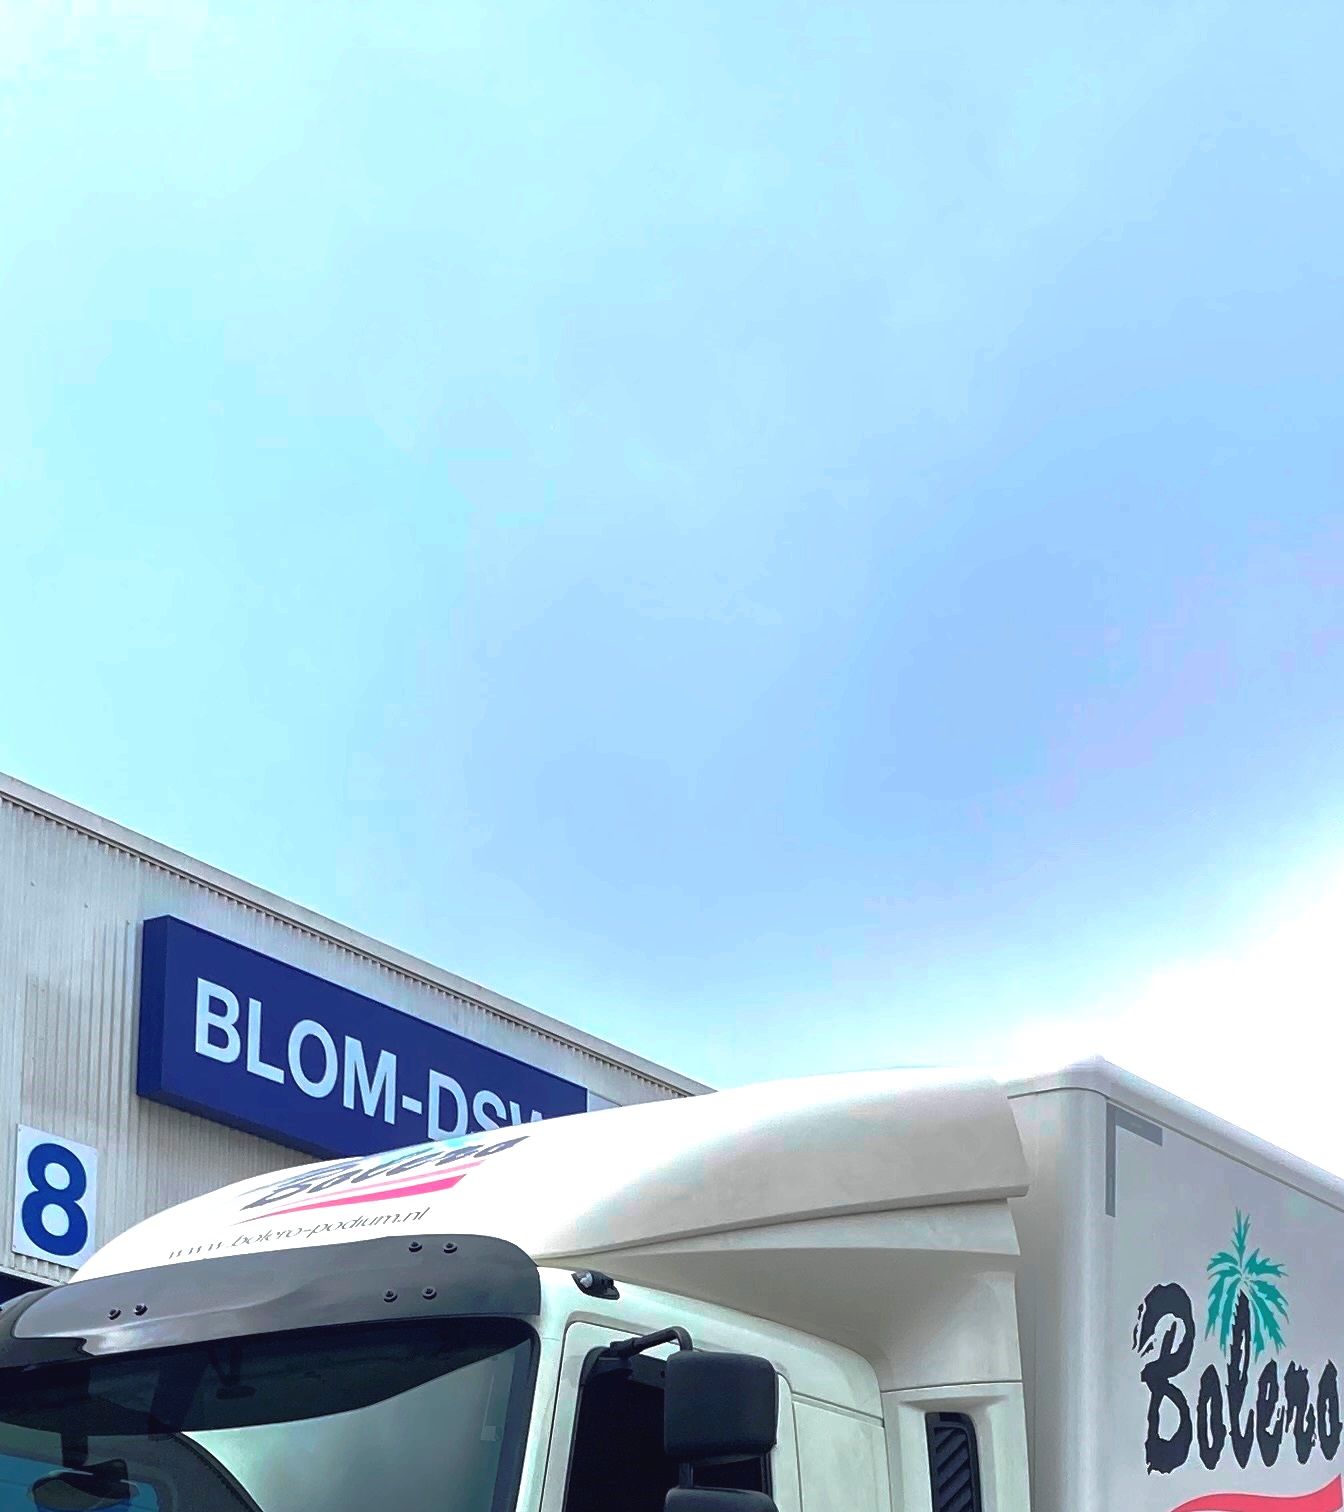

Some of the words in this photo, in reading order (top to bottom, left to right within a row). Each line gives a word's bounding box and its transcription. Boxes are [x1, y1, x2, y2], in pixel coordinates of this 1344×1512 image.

[20, 1141, 90, 1258] 8
[168, 1206, 431, 1259] www.bolero-podium.nl
[1131, 1281, 1344, 1475] Bolero
